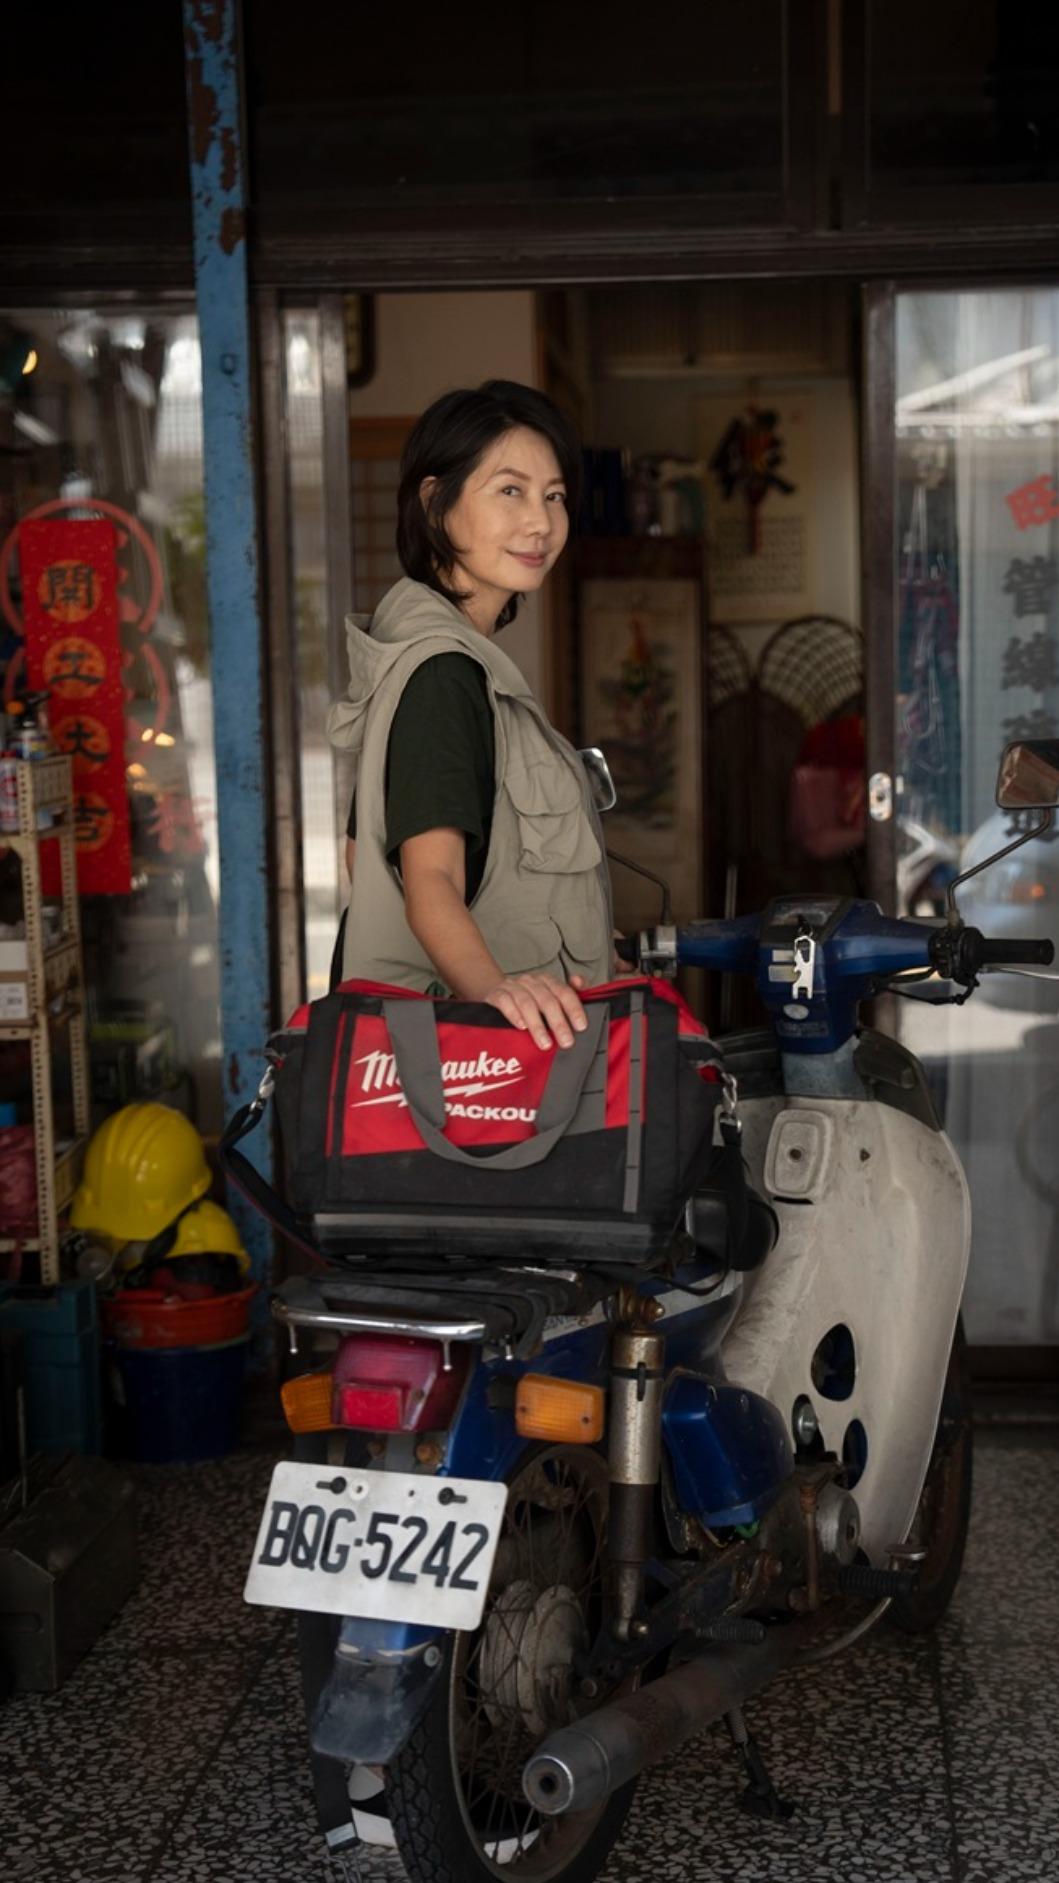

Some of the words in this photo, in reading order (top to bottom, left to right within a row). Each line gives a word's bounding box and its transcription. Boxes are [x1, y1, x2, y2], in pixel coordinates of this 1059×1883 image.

[43, 563, 108, 843] 開工大吉
[354, 1050, 523, 1093] Maukee
[444, 1102, 538, 1123] ACKOU
[257, 1501, 489, 1591] BQG-5242
